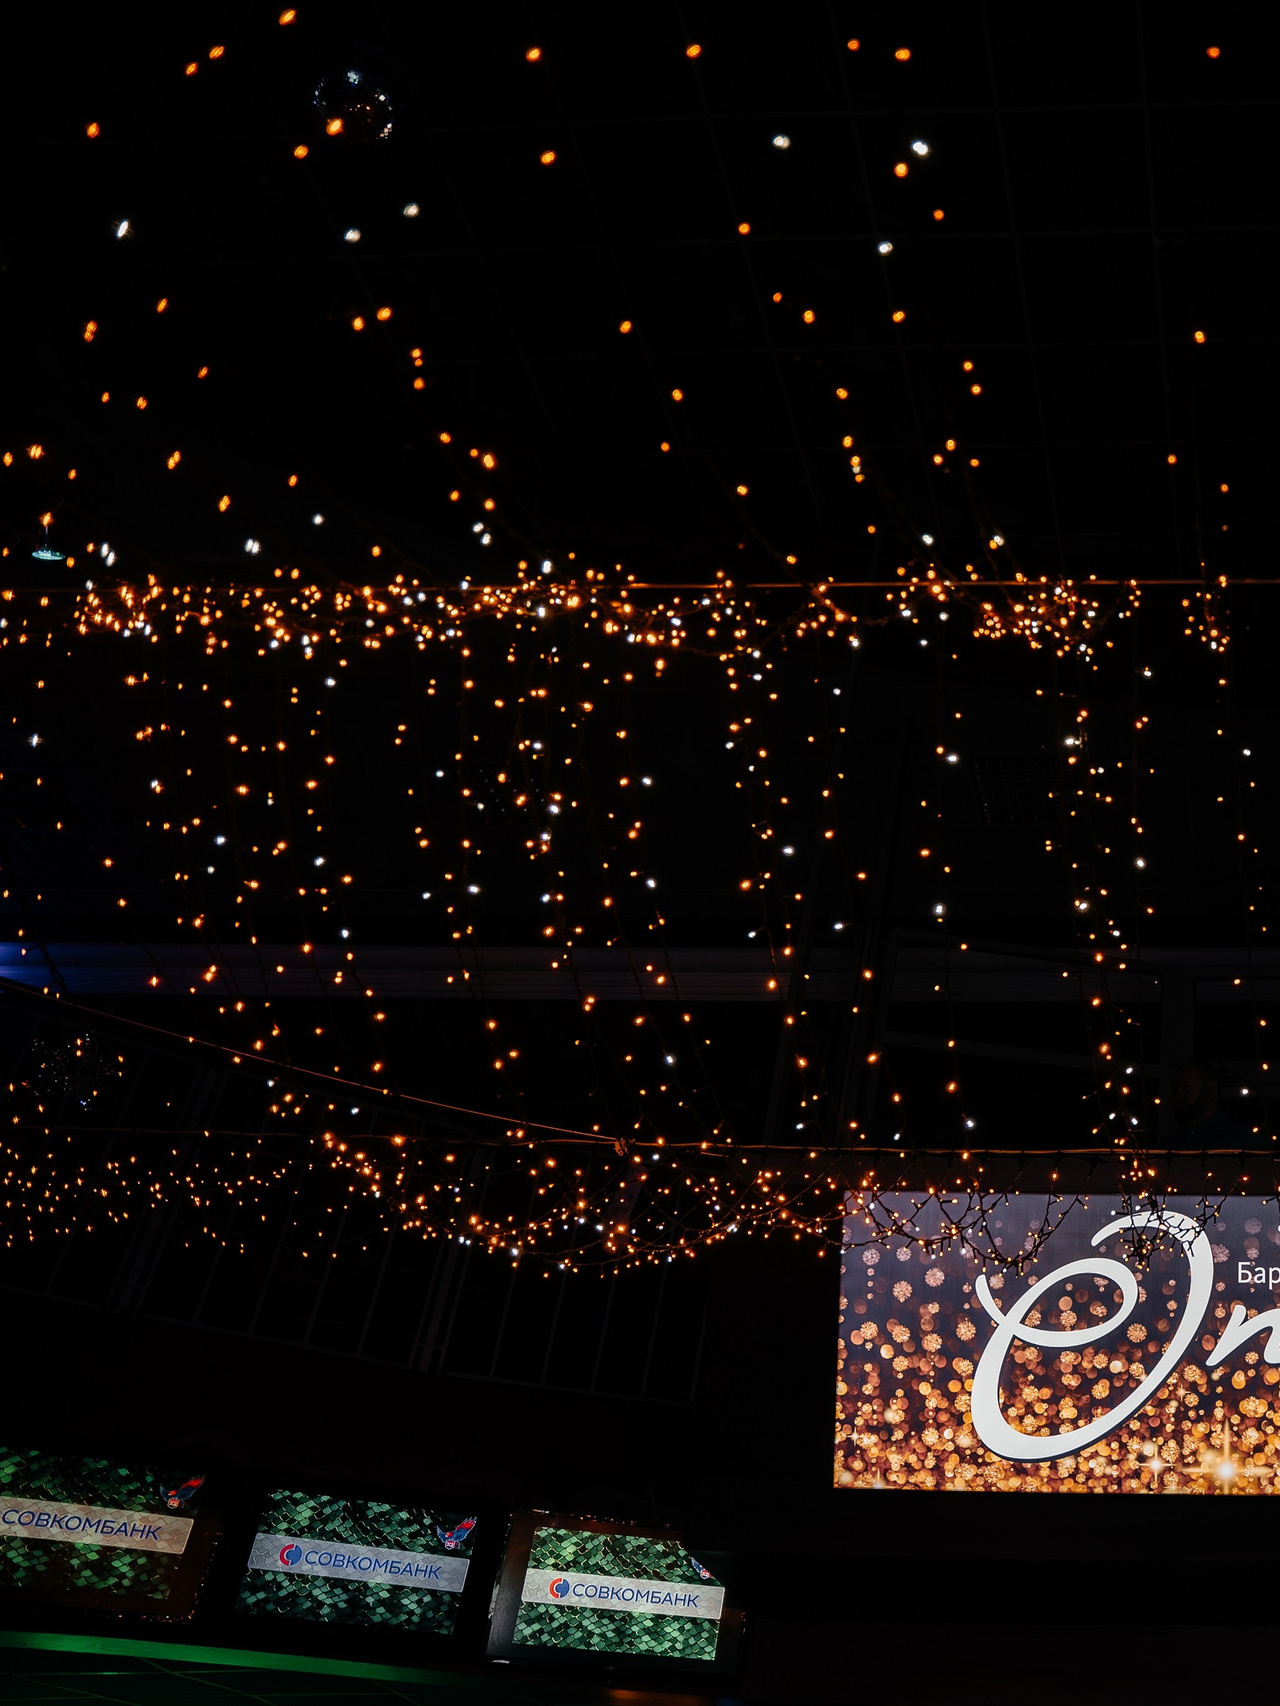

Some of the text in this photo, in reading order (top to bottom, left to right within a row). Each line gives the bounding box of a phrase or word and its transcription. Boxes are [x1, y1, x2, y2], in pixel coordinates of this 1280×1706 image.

[2, 1509, 162, 1541] СОВКОМБАНК
[305, 1550, 442, 1580] СОВКОМБАНК
[572, 1583, 700, 1608] СОВКОМБАНК
